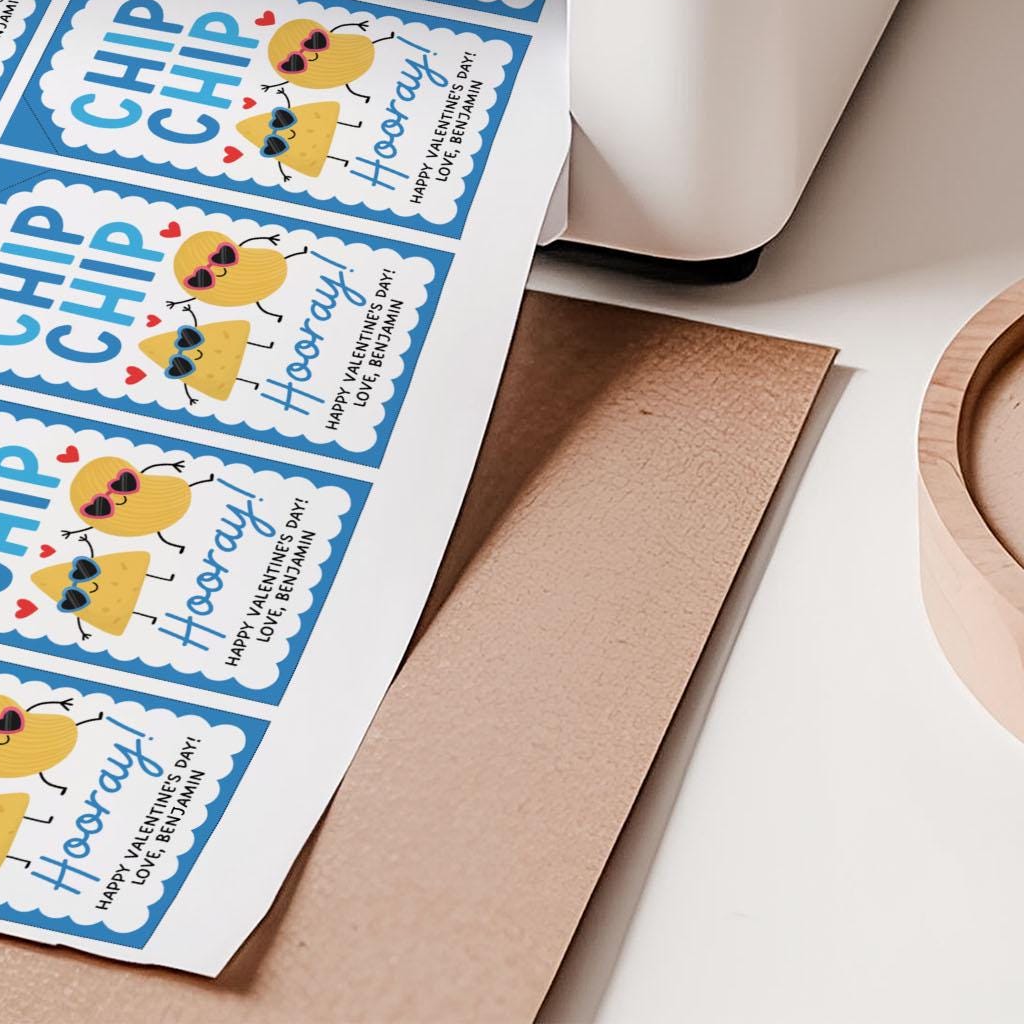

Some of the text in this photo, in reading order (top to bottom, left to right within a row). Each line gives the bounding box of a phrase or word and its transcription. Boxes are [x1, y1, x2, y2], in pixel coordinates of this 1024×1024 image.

[147, 11, 260, 144] CHIP
[351, 36, 448, 190] Hooray!
[409, 51, 477, 204] HAPPY VALENTINE'S DAY!
[434, 79, 484, 182] LOVE, BENJAMIN
[45, 221, 166, 364] CHIP
[260, 251, 367, 416] Hooray!
[324, 268, 396, 431] HAPPY VALENTINE'S DAY!
[352, 298, 404, 408] LOVE, BENJAMIN
[159, 479, 276, 652] Hooray!
[224, 497, 309, 667] HAPPY VALENTINE'S DAY!
[256, 529, 316, 643] LOVE, BENJAMIN
[32, 716, 164, 895] Hooray!
[95, 736, 201, 911] HAPPY VALENTINE'S DAY!
[131, 769, 206, 886] LOVE, BENJAMIN
